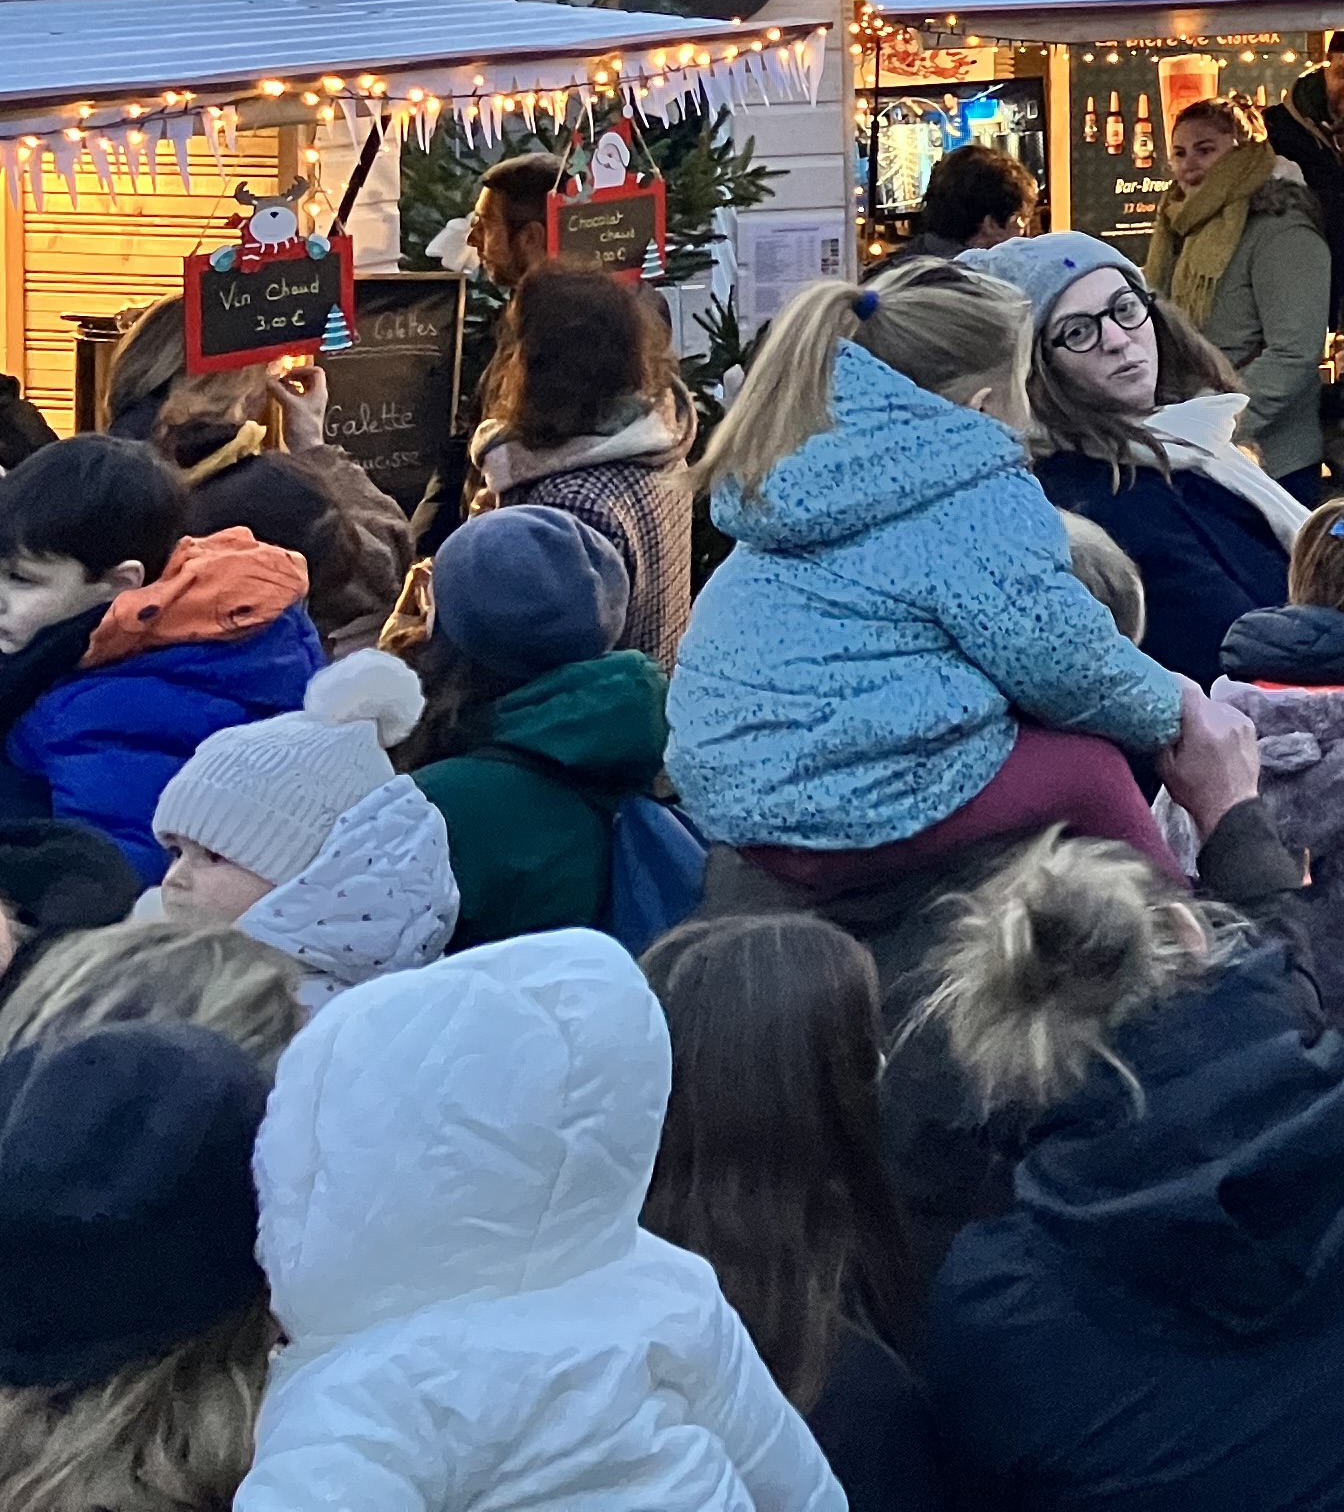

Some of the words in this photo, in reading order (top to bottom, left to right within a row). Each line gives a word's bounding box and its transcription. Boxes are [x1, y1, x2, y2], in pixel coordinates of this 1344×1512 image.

[568, 210, 624, 232] Chocolat
[219, 280, 251, 311] Vin
[324, 401, 417, 437] Galette
[345, 449, 424, 471] aucisse
